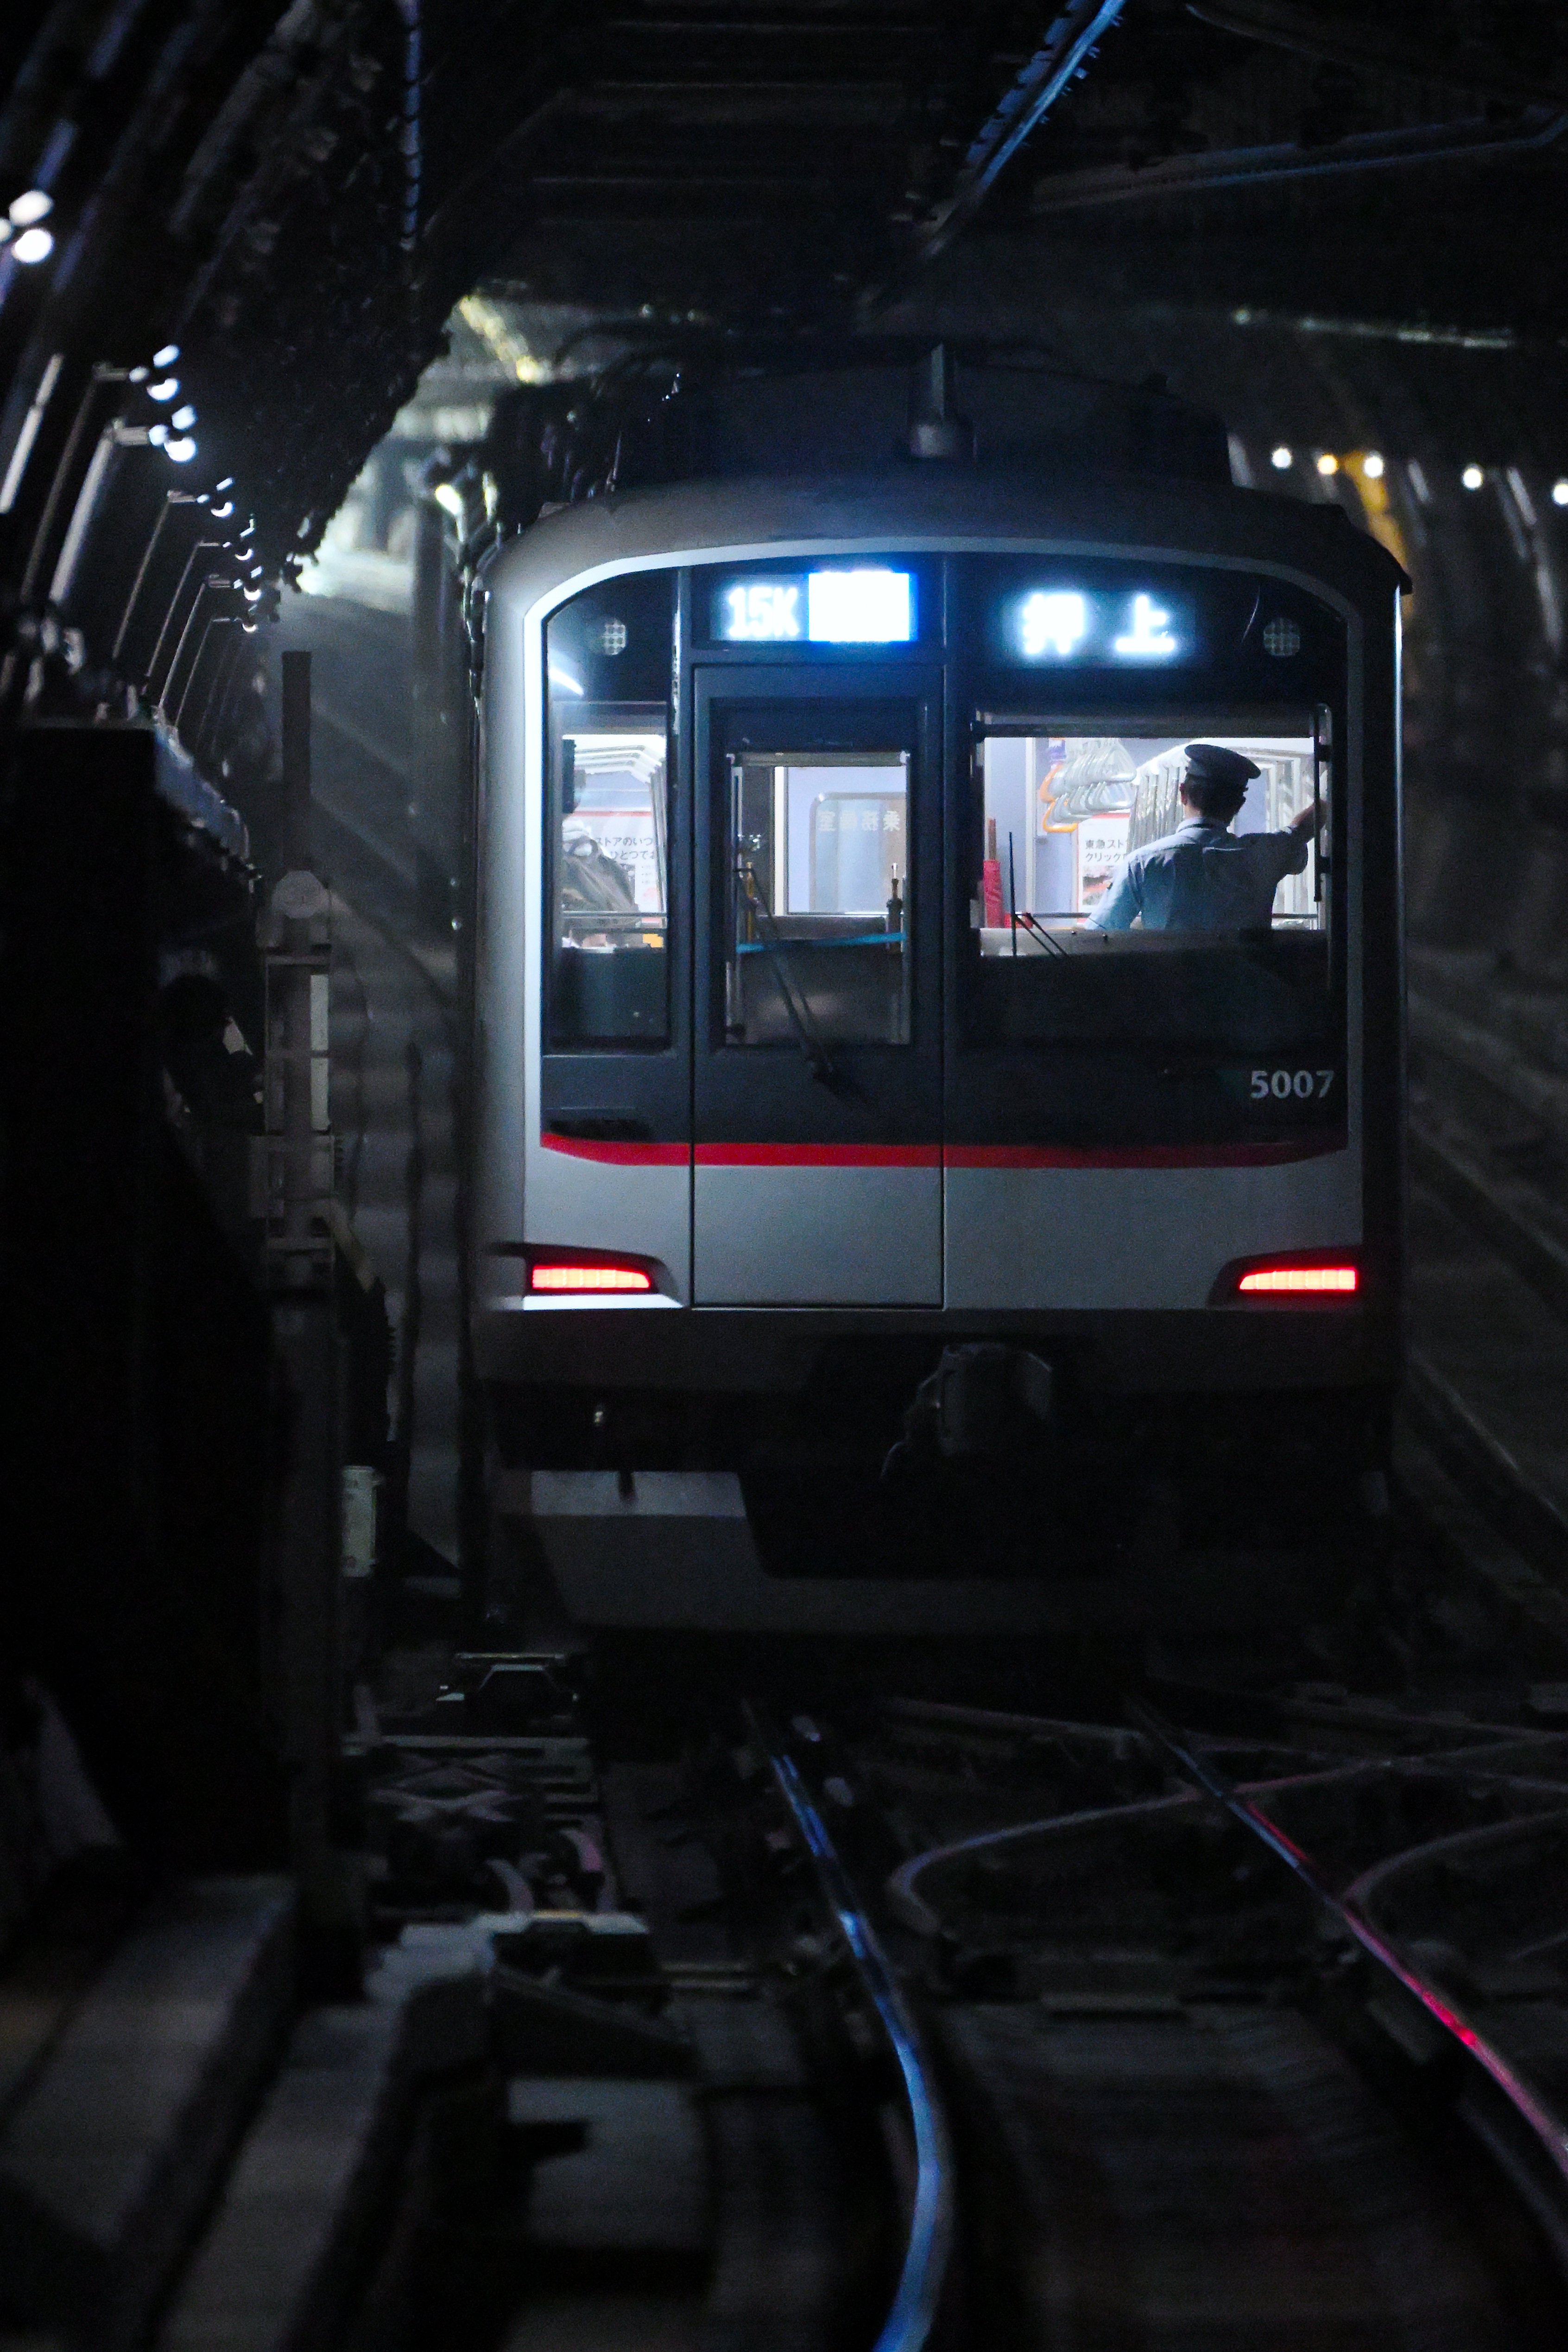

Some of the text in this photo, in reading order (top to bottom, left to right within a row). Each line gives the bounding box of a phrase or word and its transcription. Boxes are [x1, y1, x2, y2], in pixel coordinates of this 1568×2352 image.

[728, 587, 800, 637] 15K
[1085, 839, 1127, 850] 東急スト
[1251, 1070, 1334, 1099] 5007
